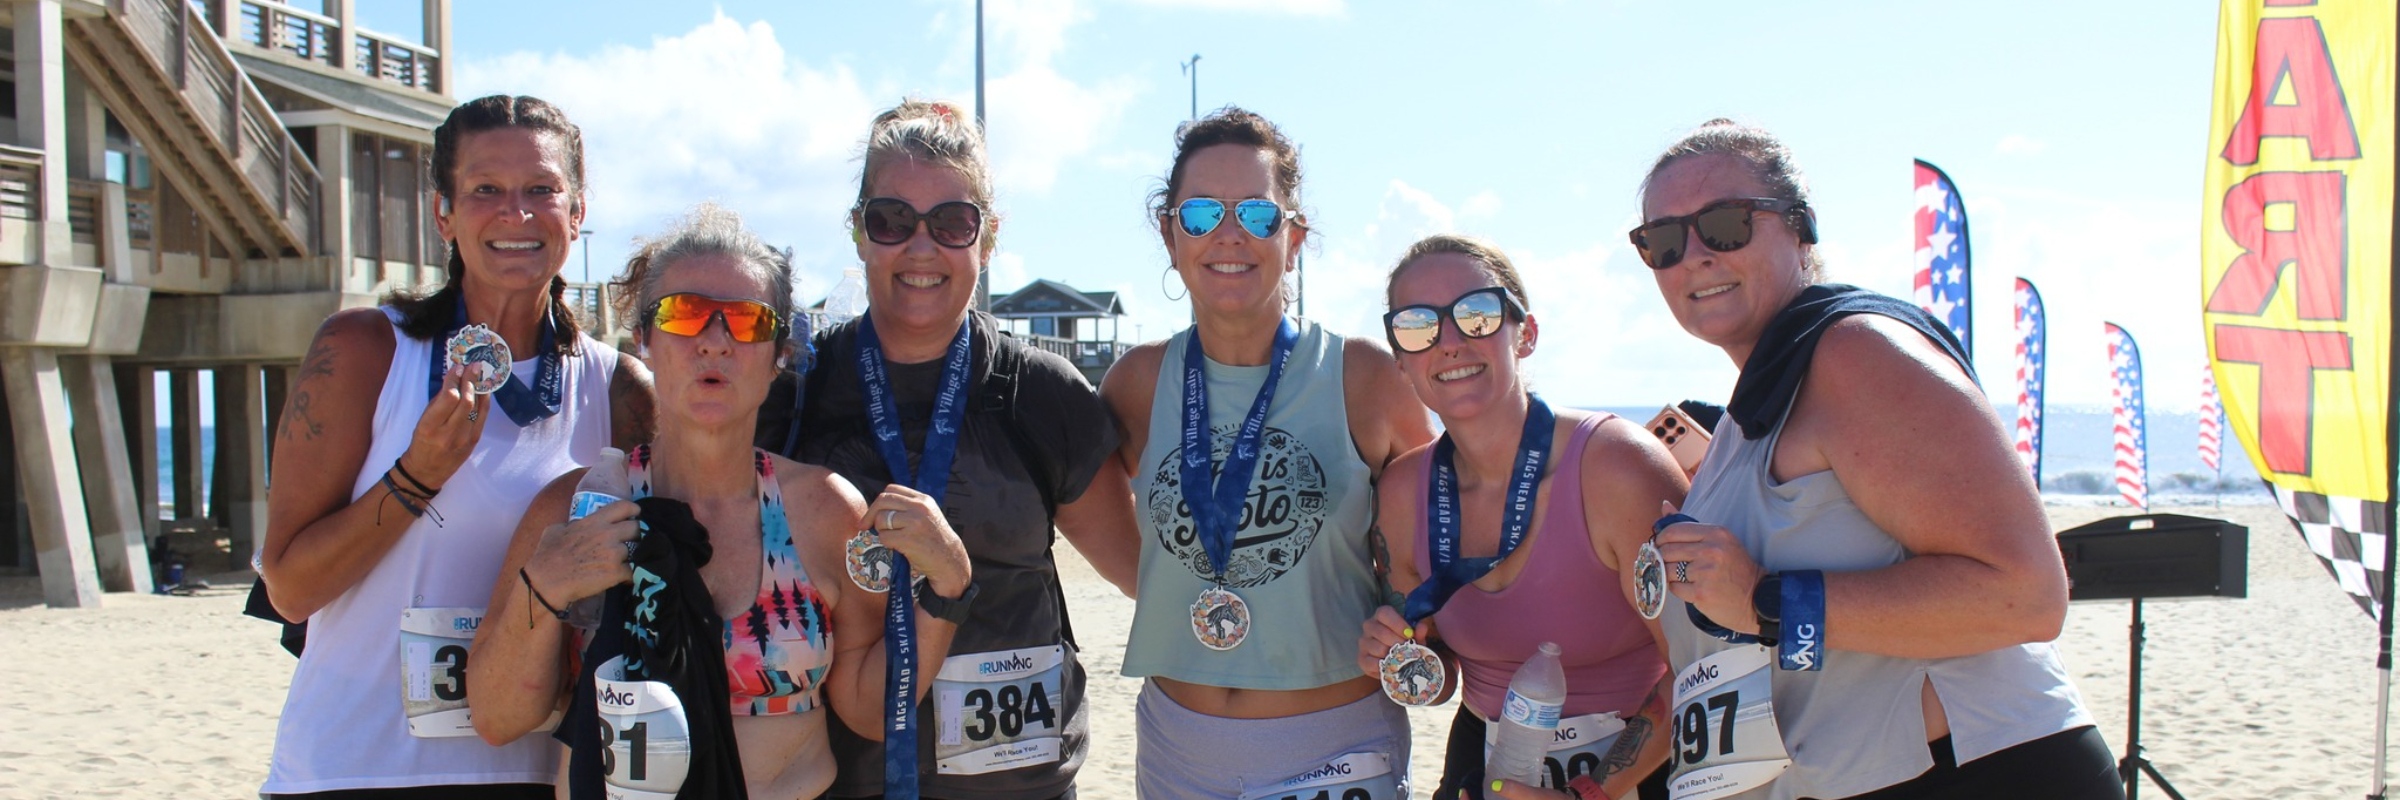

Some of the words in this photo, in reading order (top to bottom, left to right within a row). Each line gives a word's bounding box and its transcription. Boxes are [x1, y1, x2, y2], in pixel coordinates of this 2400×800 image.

[860, 347, 876, 383] Realty
[938, 373, 960, 414] Village
[950, 333, 970, 372] Realty
[1187, 368, 1198, 406] Realty
[868, 383, 885, 425] Village
[1186, 407, 1200, 450] Village
[1261, 453, 1289, 482] is
[1438, 464, 1449, 493] NAGS
[1523, 449, 1541, 479] NAGS
[1301, 498, 1319, 509] 123
[1438, 495, 1451, 524] HEAD
[1515, 481, 1531, 511] HEAD
[1438, 537, 1451, 563] 5K/1
[897, 627, 910, 654] 5K/1
[898, 668, 911, 698] HEAD
[895, 700, 907, 731] NAGS
[965, 682, 1056, 742] 384
[1690, 778, 1706, 788] Race
